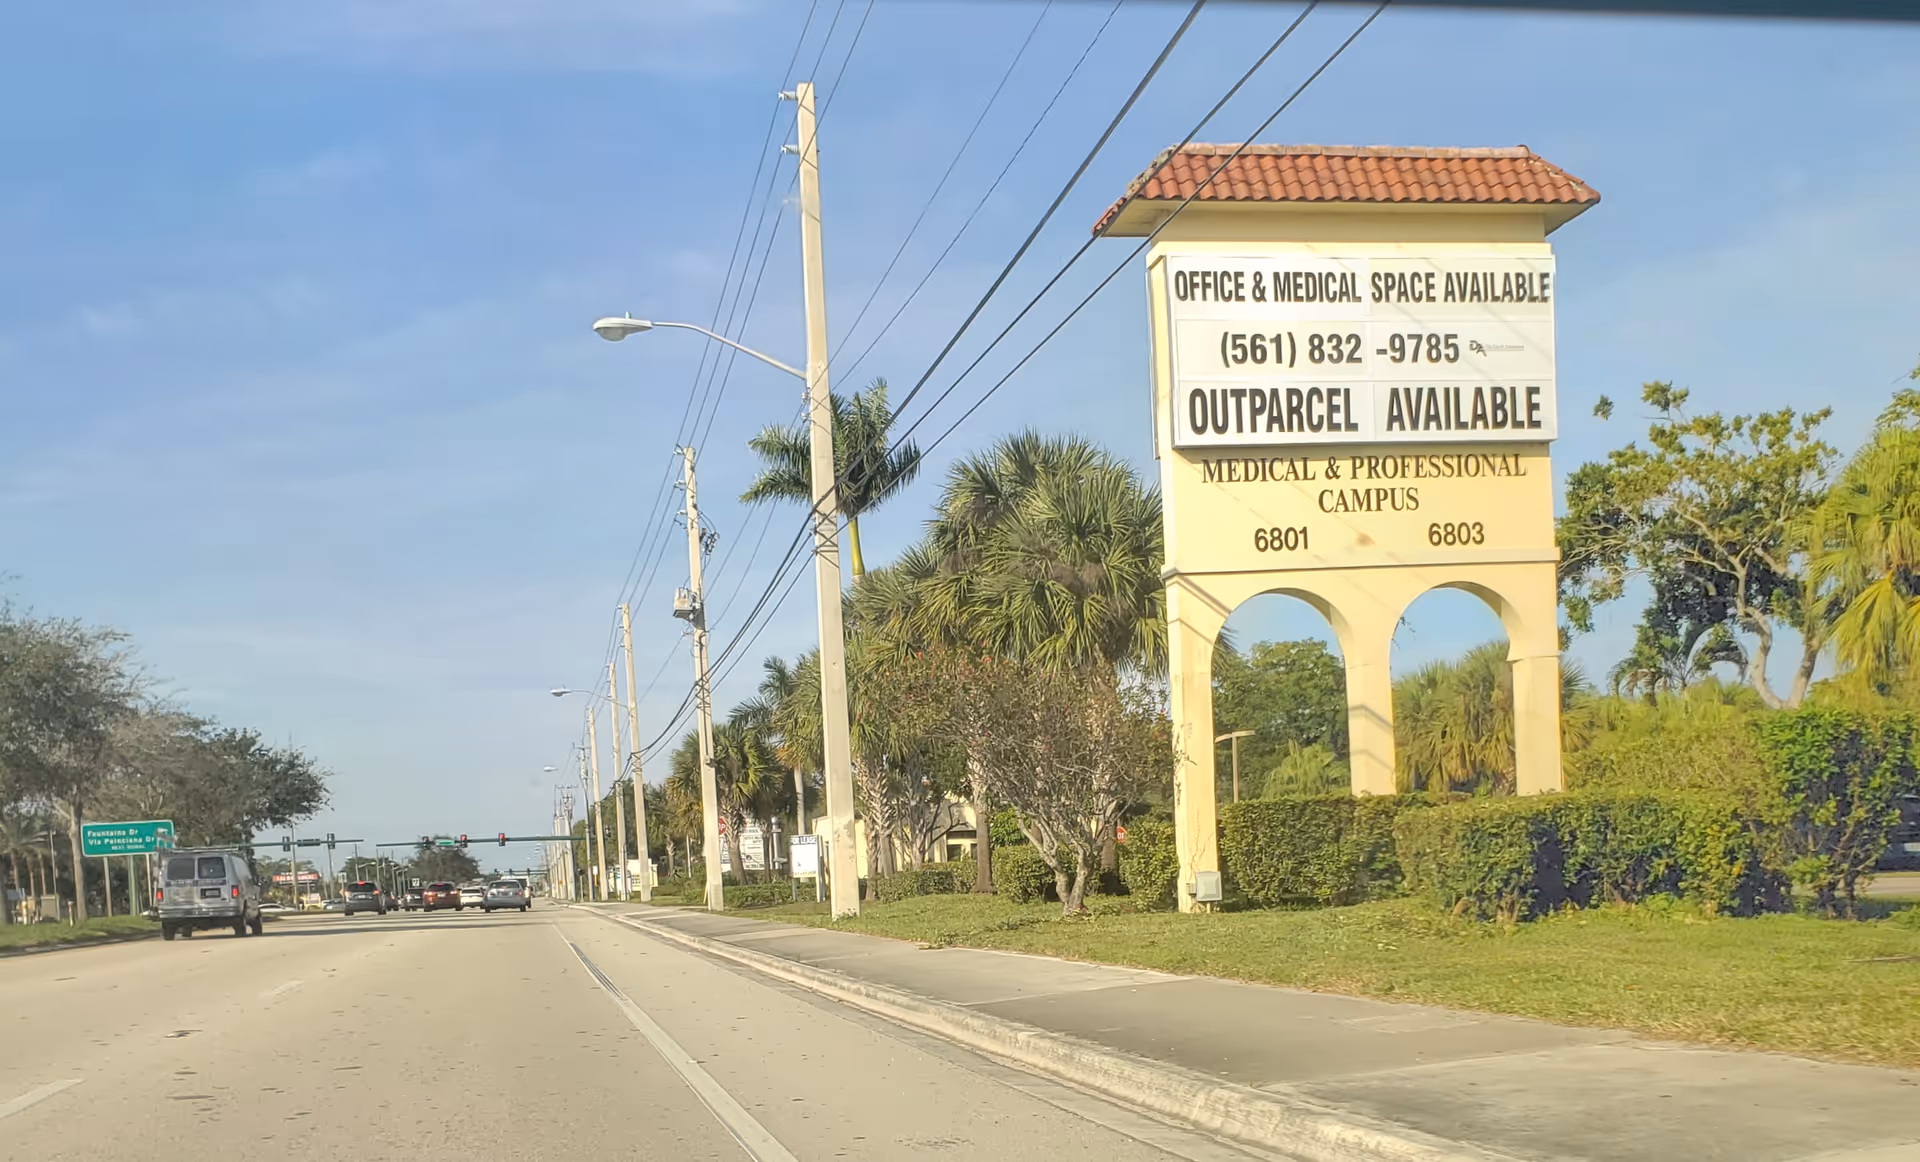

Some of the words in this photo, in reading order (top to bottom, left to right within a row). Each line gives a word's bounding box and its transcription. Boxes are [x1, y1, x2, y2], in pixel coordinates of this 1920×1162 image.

[1174, 270, 1246, 302] OFFICE
[1252, 271, 1267, 303] &
[1273, 271, 1362, 303] MEDICAL
[1371, 272, 1437, 303] SPACE
[1443, 272, 1551, 303] AVAILABLE
[1220, 331, 1297, 368] (561)
[1308, 333, 1363, 365] 832
[1189, 387, 1359, 435] OUTPARCEL
[1386, 386, 1542, 432] AVAILABLE
[1201, 456, 1317, 484] MEDICAL
[1325, 456, 1341, 480] &
[1350, 453, 1528, 481] PROFESSIONAL
[1318, 487, 1420, 513] CAMPUS
[1254, 526, 1309, 553] 6801
[1428, 522, 1485, 547] 6803
[800, 835, 817, 844] LEASE
